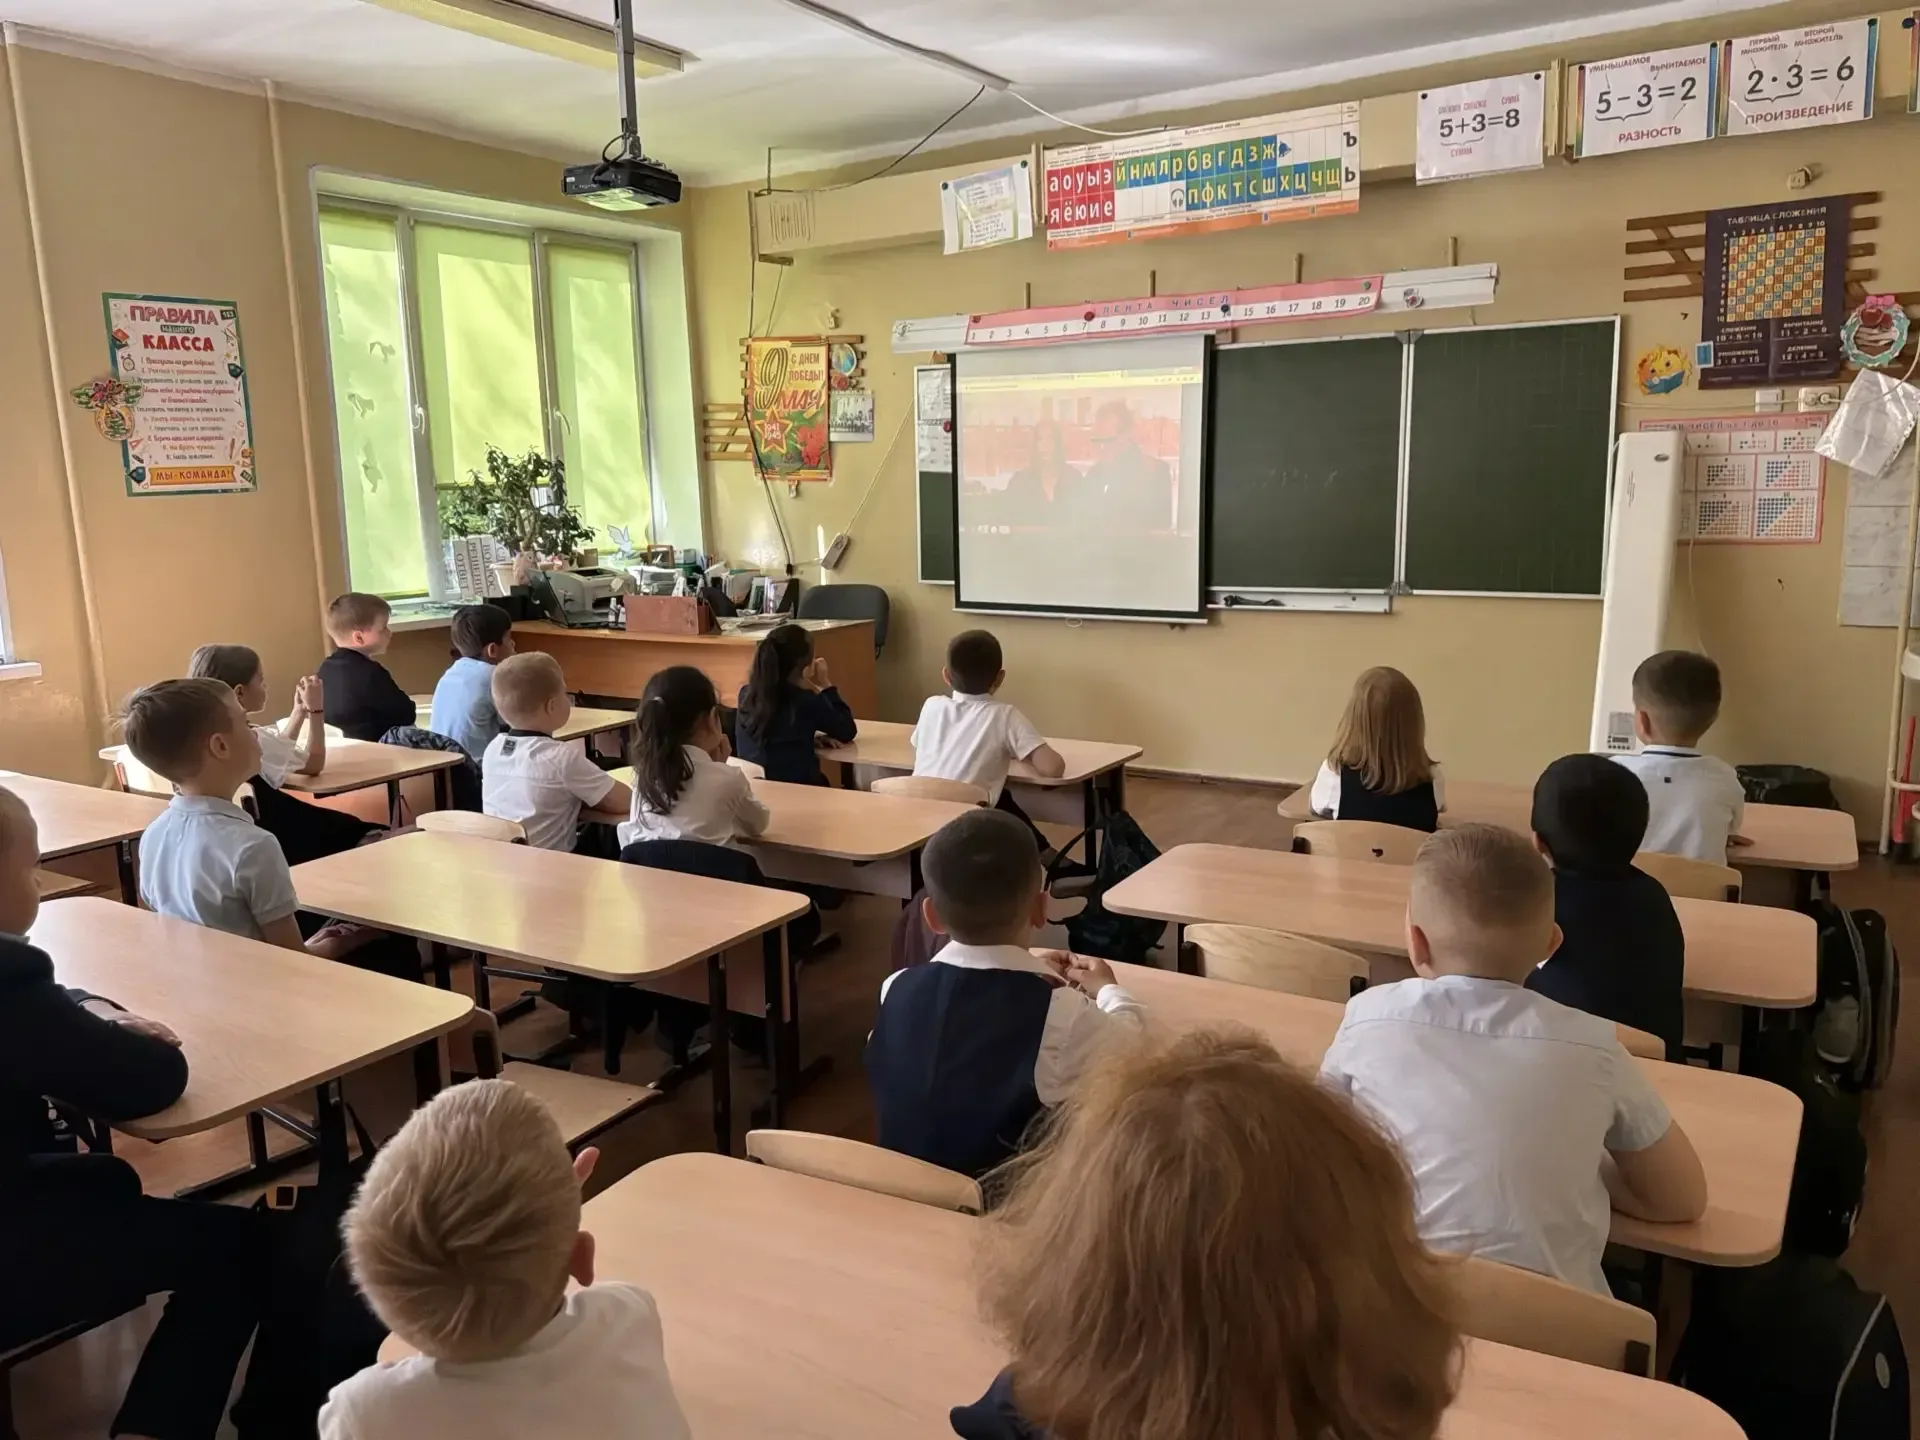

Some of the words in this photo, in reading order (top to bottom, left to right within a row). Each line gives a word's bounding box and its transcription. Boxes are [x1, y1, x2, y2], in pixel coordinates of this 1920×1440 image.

[1749, 34, 1780, 47] ПЕРВЫЙ
[1794, 34, 1844, 47] МНОЖИТЕЛЬ
[1804, 26, 1834, 37] ВТОРОЙ
[1741, 43, 1788, 56] МНОЖИТЕЛЬ
[1589, 56, 1651, 73] УМЕНЬШАЕМОЕ
[1650, 57, 1706, 72] ВЫЧИТАЕМОЕ
[1747, 70, 1764, 94] 2
[1786, 64, 1803, 88] 3
[1836, 56, 1854, 81] 6
[1596, 91, 1611, 114] 5
[1637, 84, 1652, 108] 3
[1681, 76, 1696, 100] 2
[1745, 100, 1853, 124] ПРОИЗВЕДЕНИЕ
[1618, 126, 1682, 142] РАЗНОСТЬ
[1728, 214, 1770, 226] ТАБЛИЦА
[1772, 206, 1826, 220] СЛОЖЕНИЯ
[1103, 303, 1152, 314] ЛЕНТА
[1173, 295, 1229, 306] ЧИСЕЛ
[130, 305, 219, 326] ПРАВИЛА
[972, 332, 976, 340] 1
[1007, 329, 1012, 337] 3
[1025, 328, 1030, 336] 4
[1044, 326, 1049, 334] 5
[1063, 324, 1068, 332] 6
[1082, 322, 1087, 331] 7
[1101, 320, 1106, 328] 8
[1120, 319, 1126, 327] 9
[1139, 316, 1148, 326] 10
[1158, 314, 1167, 323] 11
[1180, 313, 1189, 321] 12
[1201, 311, 1210, 320] 13
[1244, 307, 1254, 316] 15
[1266, 305, 1276, 314] 16
[1289, 303, 1299, 312] 17
[1312, 301, 1322, 310] 18
[1334, 299, 1346, 308] 19
[1358, 296, 1370, 306] 20
[142, 334, 215, 352] КЛАССА
[792, 353, 796, 364] С
[754, 348, 788, 410] 9
[789, 370, 823, 382] ПОБЕДЫ!
[156, 472, 173, 480] МЫ
[180, 470, 230, 479] КОМАНДА!
[456, 553, 468, 589] ОТВЕТ
[470, 542, 483, 596] РЕШЕНИЕ
[483, 544, 496, 591] ВОПРОС
